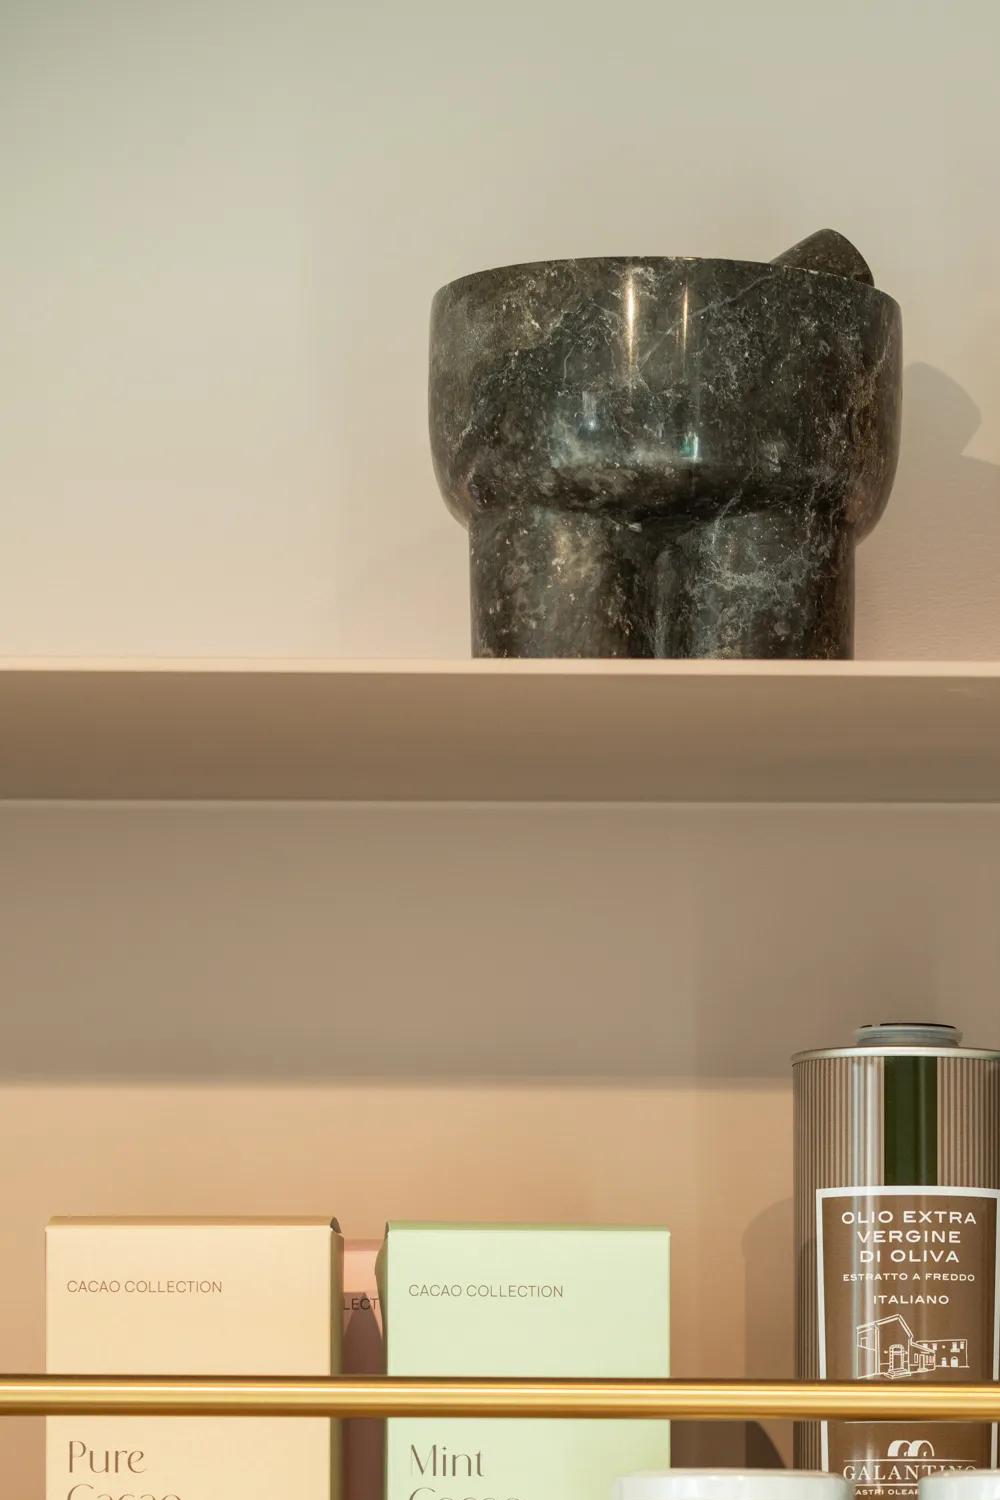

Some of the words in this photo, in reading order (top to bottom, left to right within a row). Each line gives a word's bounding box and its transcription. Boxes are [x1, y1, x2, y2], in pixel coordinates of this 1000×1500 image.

[841, 1211, 894, 1225] OLIO
[903, 1211, 977, 1225] EXTRA
[857, 1231, 961, 1244] VERGINE
[860, 1250, 881, 1263] DI
[890, 1250, 960, 1263] OLIVA
[843, 1273, 908, 1282] ESTRATTO
[912, 1273, 921, 1281] A
[925, 1273, 975, 1282] FREDDO
[66, 1280, 121, 1293] CACAO
[124, 1280, 223, 1293] COLLECTION
[408, 1284, 462, 1297] CACAO
[466, 1284, 564, 1298] COLLECTION
[343, 1298, 378, 1311] LECT
[873, 1295, 949, 1305] ITALIANO
[68, 1440, 147, 1474] Pure
[410, 1444, 485, 1477] Mint
[887, 1488, 919, 1496] OLEAR
